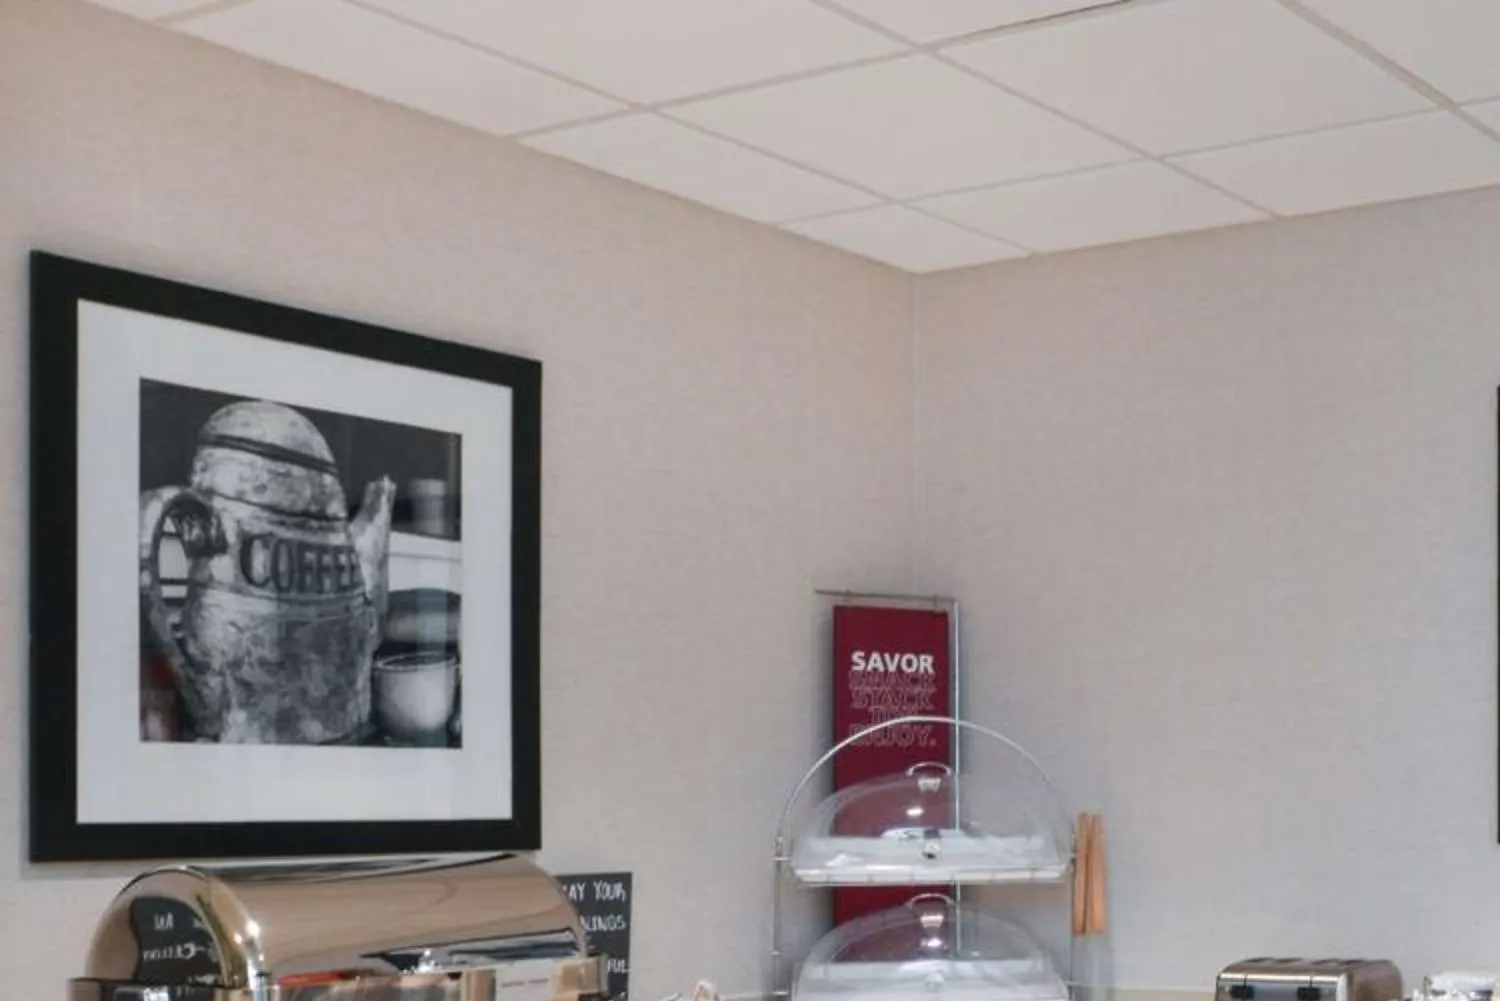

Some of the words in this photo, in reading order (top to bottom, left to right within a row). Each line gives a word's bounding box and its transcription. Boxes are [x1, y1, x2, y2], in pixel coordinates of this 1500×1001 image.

[240, 532, 363, 594] COFFEE
[851, 651, 934, 673] SAVOR
[562, 882, 586, 901] AY
[607, 959, 630, 973] FUL
